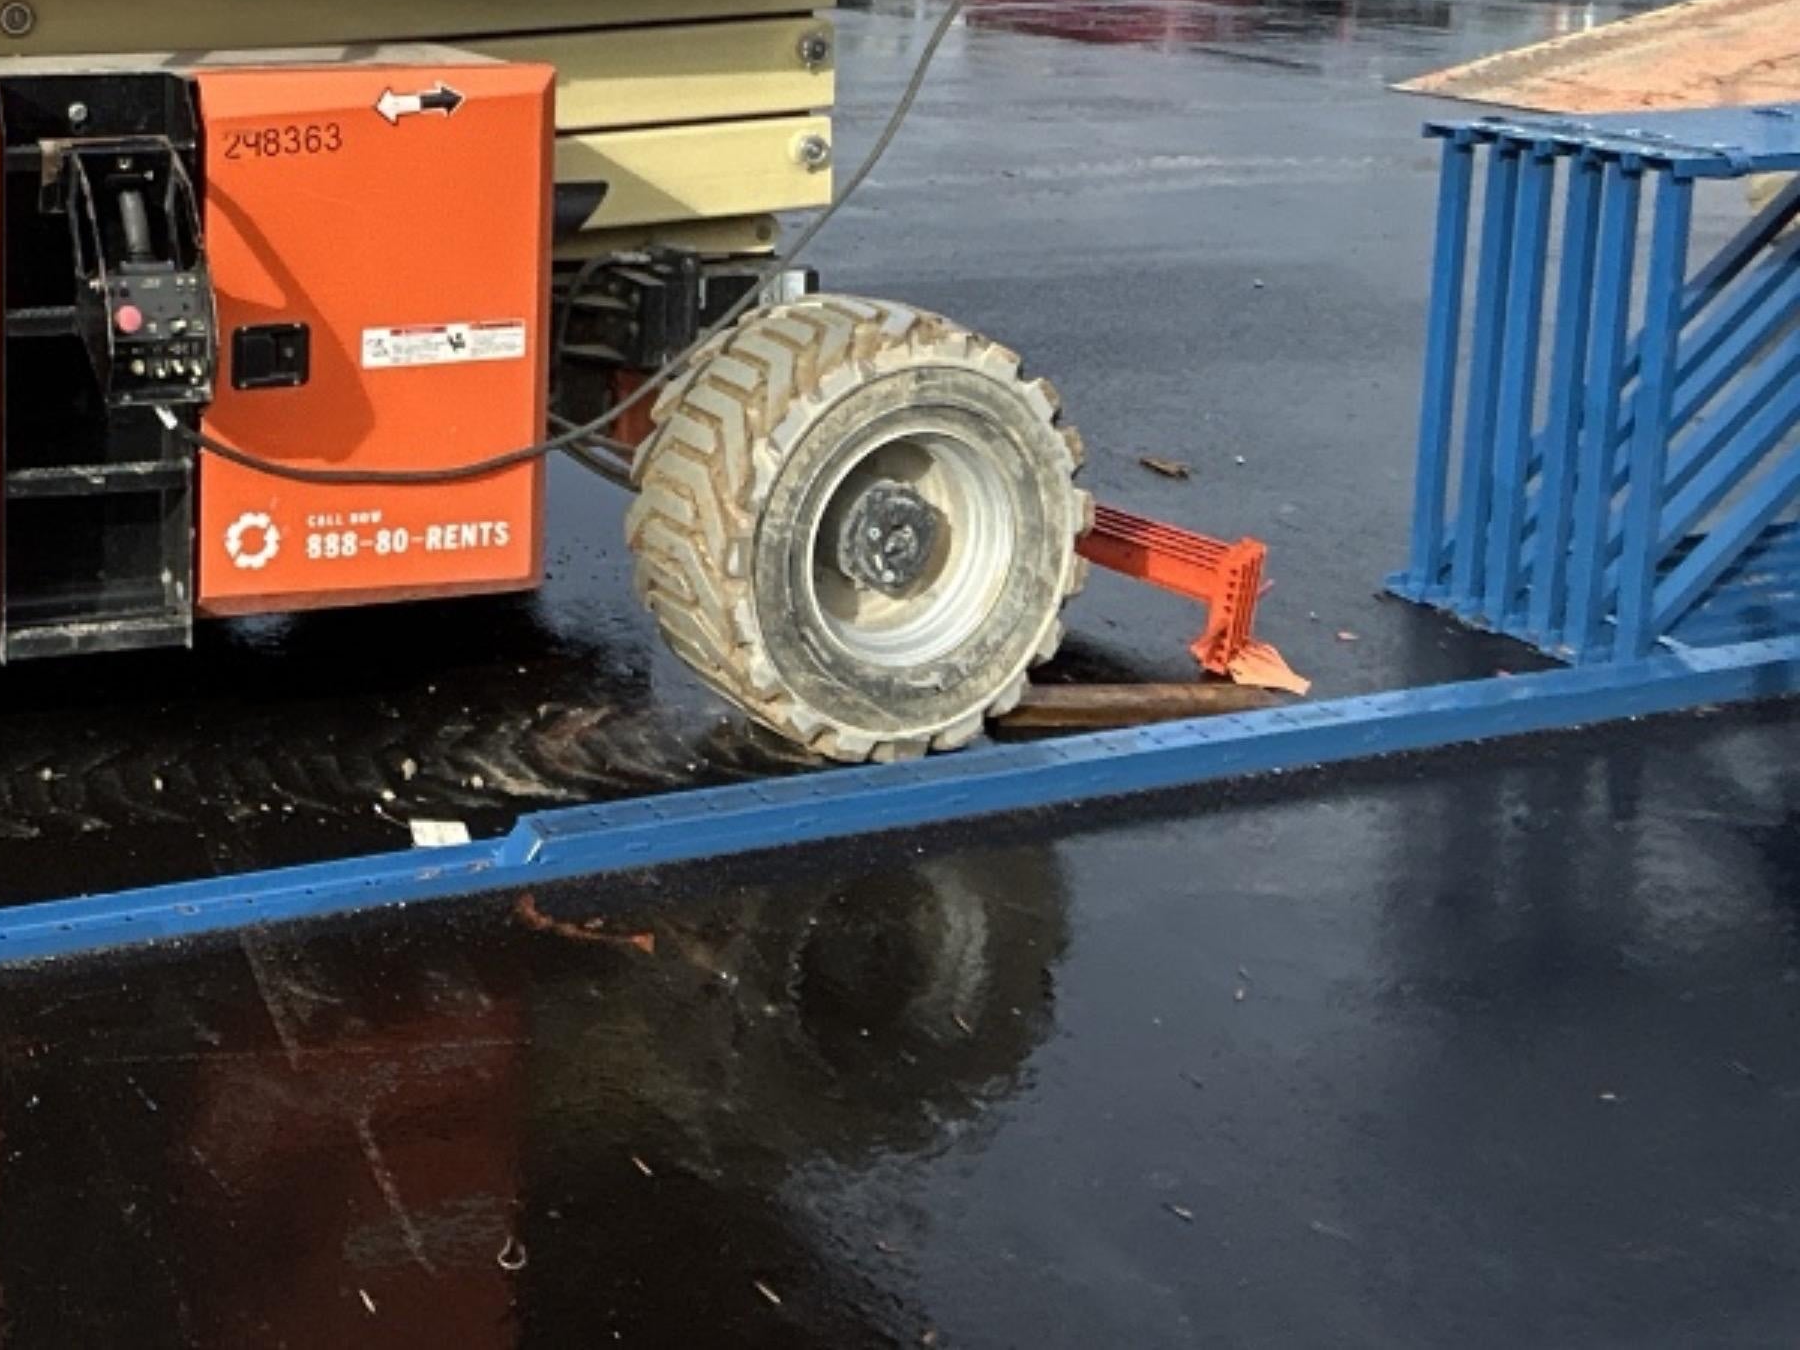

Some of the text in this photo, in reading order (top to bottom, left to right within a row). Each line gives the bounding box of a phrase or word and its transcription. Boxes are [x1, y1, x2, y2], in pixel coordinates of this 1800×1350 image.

[223, 121, 344, 160] 248363
[306, 510, 382, 528] CALL NOW
[306, 520, 510, 560] 888-80-RENTS
